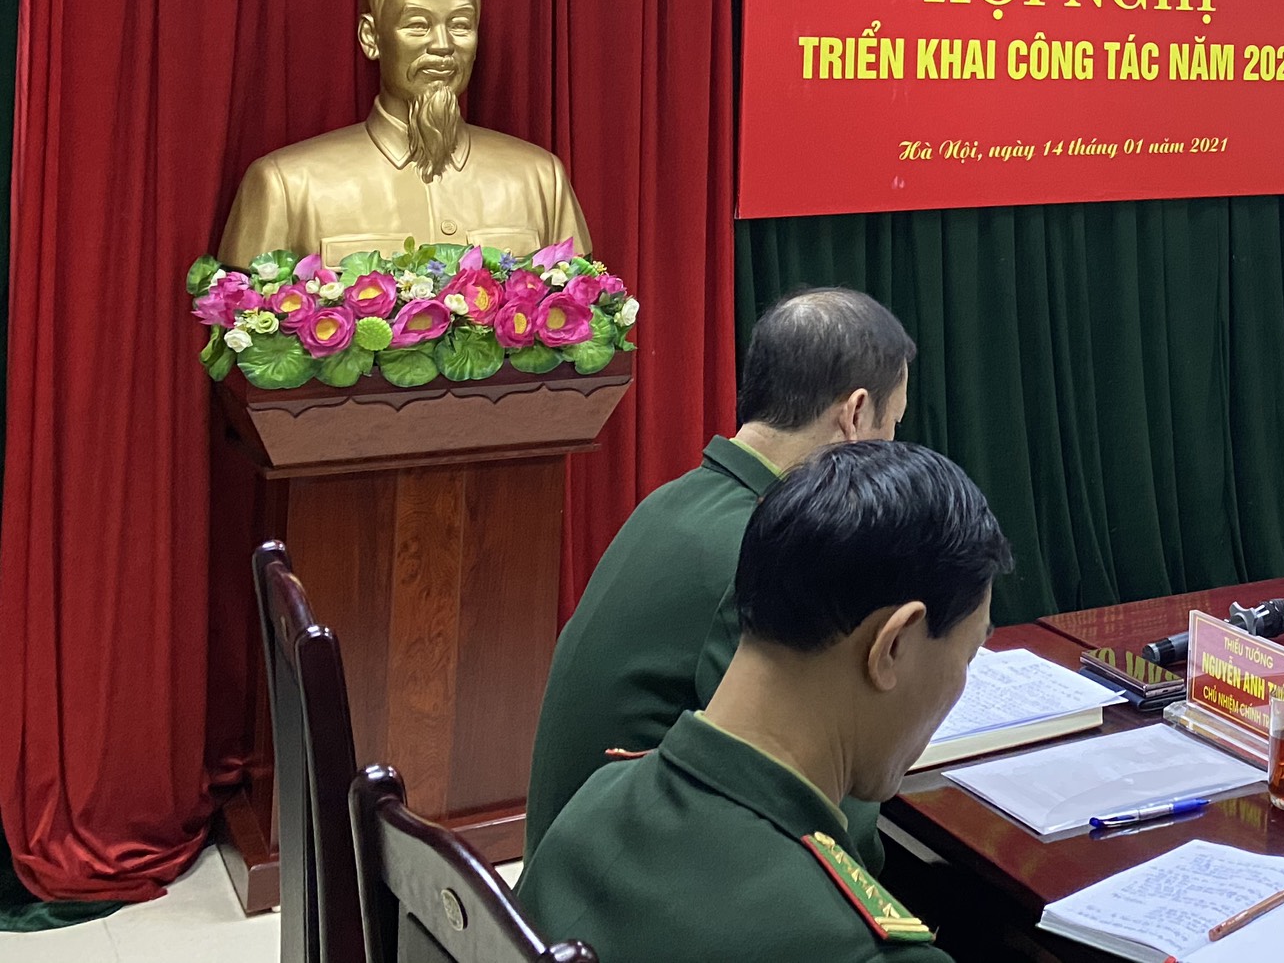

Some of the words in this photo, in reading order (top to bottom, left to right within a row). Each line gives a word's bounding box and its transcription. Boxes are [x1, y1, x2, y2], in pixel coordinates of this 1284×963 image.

[798, 19, 905, 80] TRIỂN
[916, 38, 996, 80] KHAI
[1007, 32, 1094, 81] CÔNG
[1104, 33, 1160, 81] TÁC
[1169, 36, 1235, 82] NĂM
[898, 138, 932, 161] Hà
[939, 139, 984, 163] Nội,
[988, 143, 1036, 162] ngày
[1043, 140, 1064, 156] 14
[1067, 138, 1118, 159] tháng
[1123, 138, 1144, 154] 01
[1148, 138, 1186, 154] năm
[1189, 136, 1228, 153] 2021
[1224, 636, 1244, 656] THIẾU
[1245, 647, 1274, 669] TƯỚNG
[1201, 651, 1241, 689] NGUYỄN
[1243, 671, 1265, 701] ANH
[1203, 685, 1217, 703] CHỦ
[1217, 692, 1239, 714] NHIỆM
[1239, 703, 1261, 725] CHÍNH
